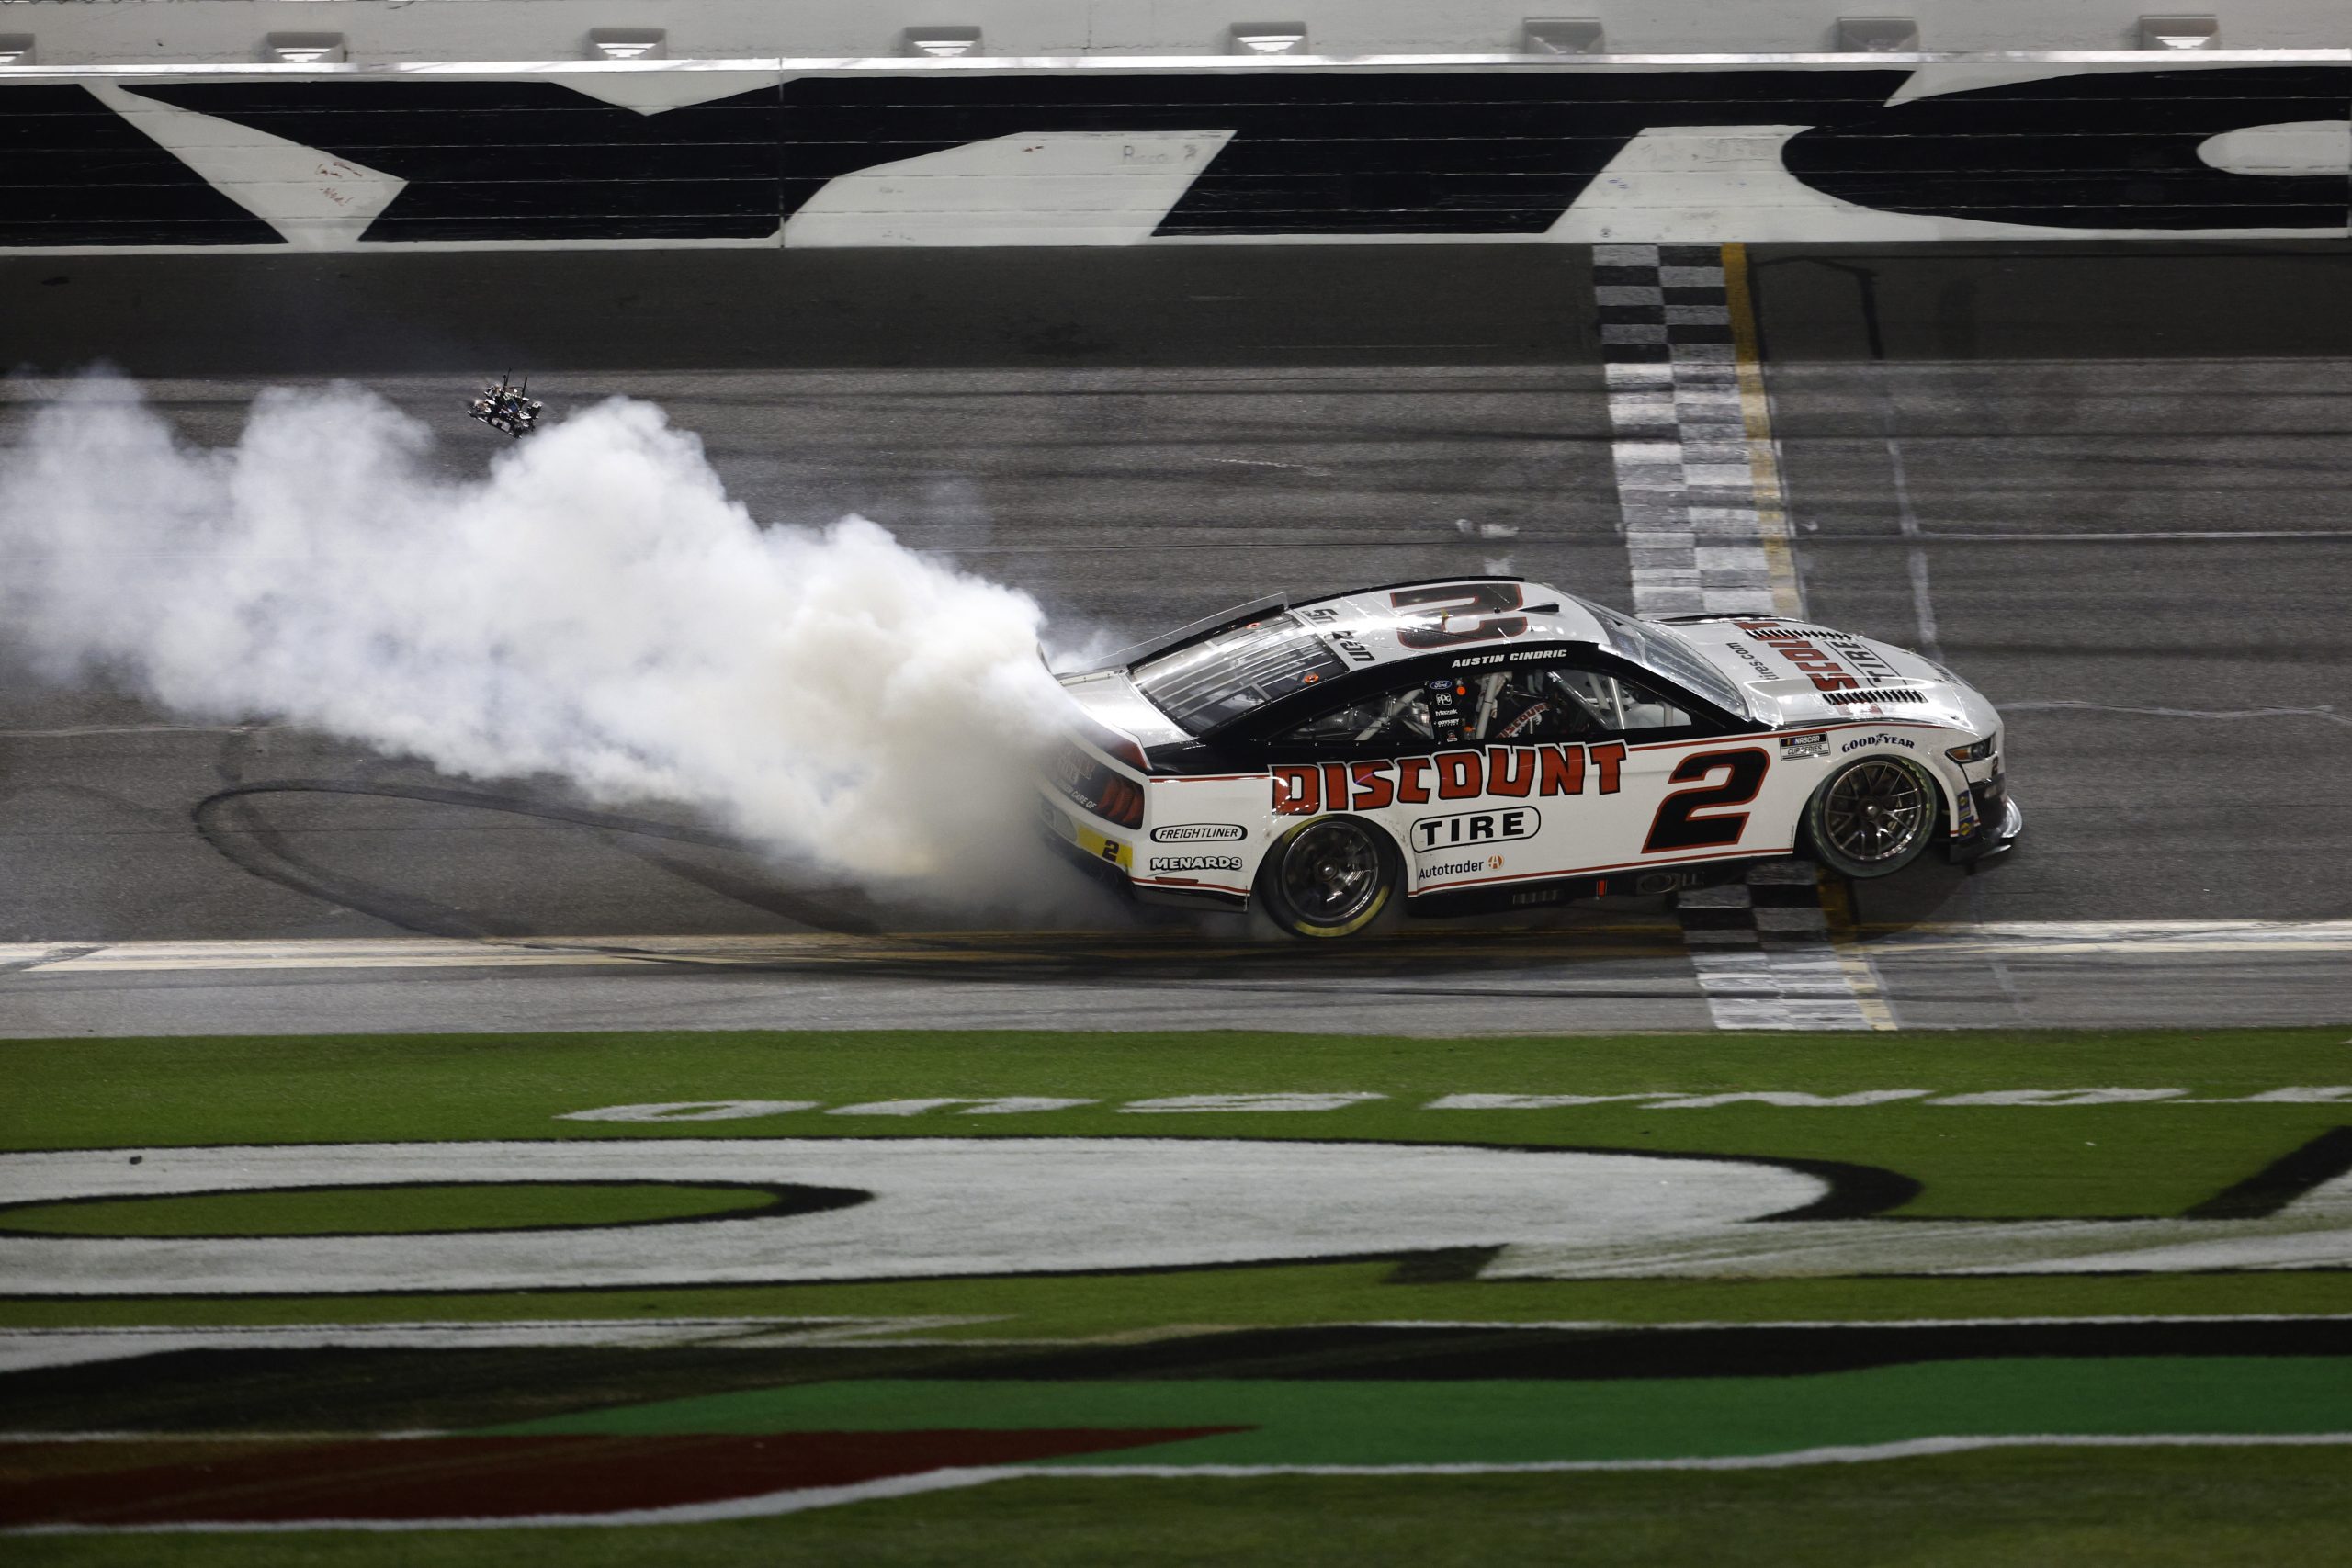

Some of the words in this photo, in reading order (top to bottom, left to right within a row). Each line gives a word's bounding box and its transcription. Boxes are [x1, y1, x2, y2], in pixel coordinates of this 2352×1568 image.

[1452, 655, 1504, 669] AUSTIN
[1509, 649, 1567, 661] CINDRIC
[1433, 681, 1450, 689] Ford
[1794, 735, 1821, 745] NASCAR
[1787, 747, 1801, 755] CUP
[1800, 745, 1821, 753] SERIES
[1270, 740, 1628, 816] DISCOUNT
[1071, 790, 1089, 805] CARE
[1086, 800, 1098, 809] OF
[1642, 747, 1770, 854] 2
[1159, 828, 1238, 840] FREIGHTLINER
[1420, 811, 1525, 846] TIRE
[1102, 840, 1119, 862] 2
[1150, 856, 1243, 871] MENARDS
[1419, 860, 1485, 881] Autotrader
